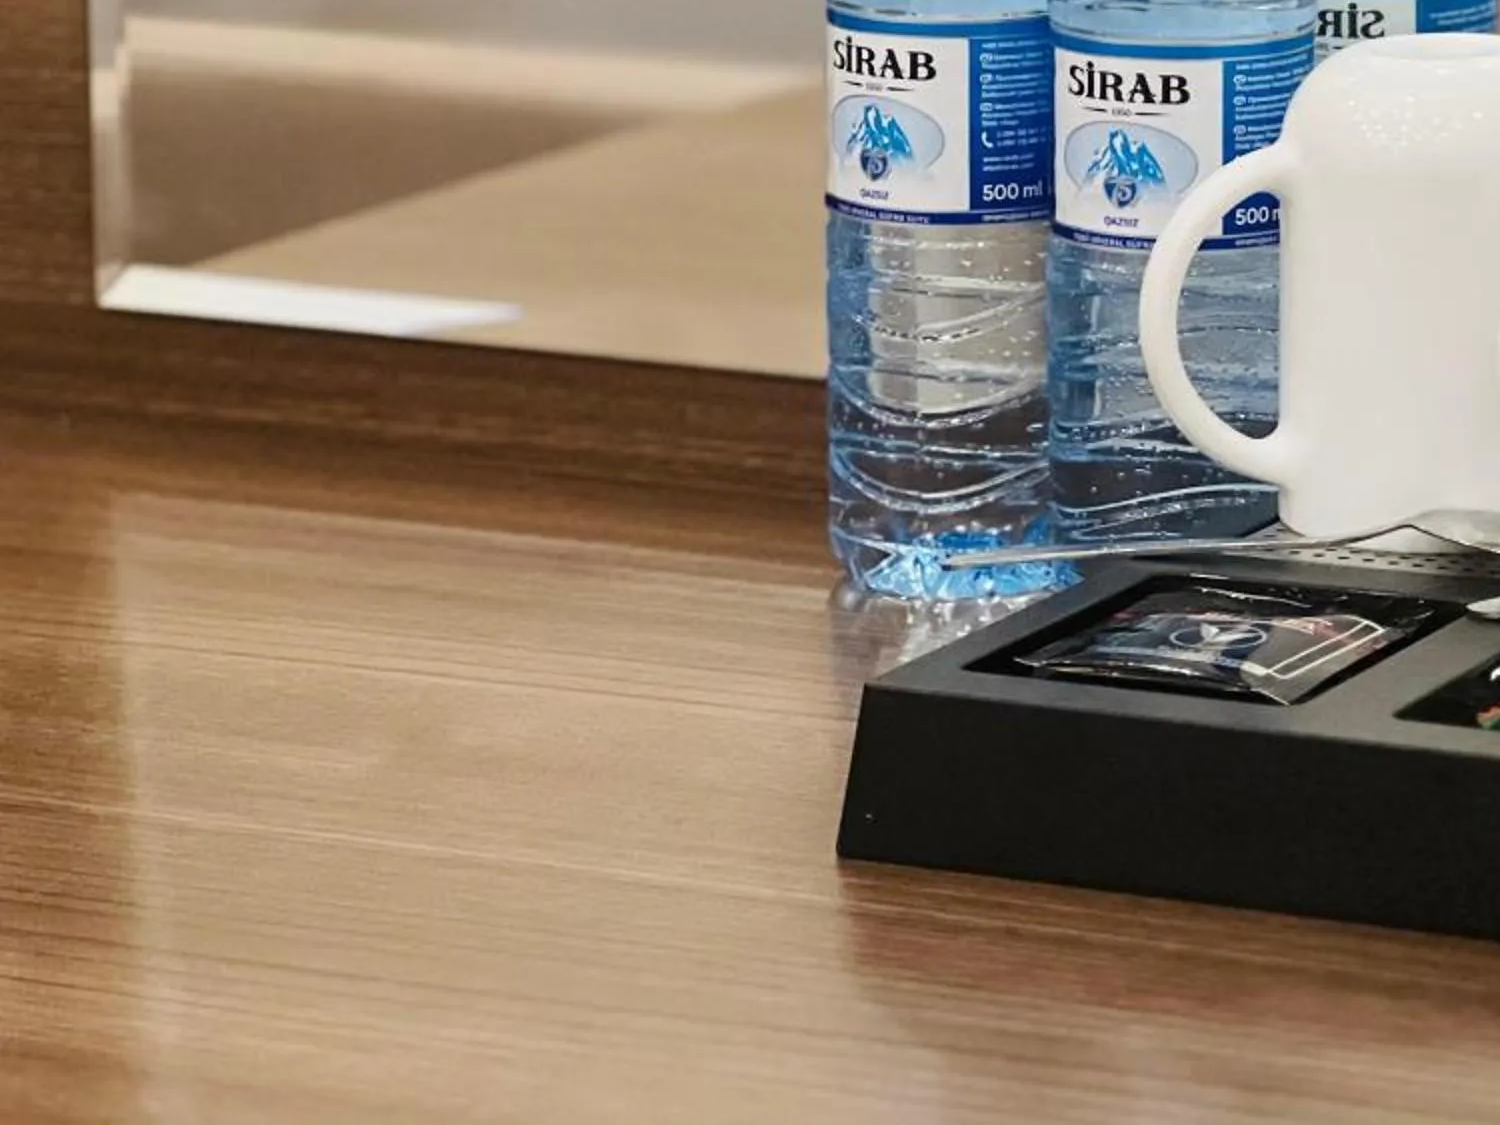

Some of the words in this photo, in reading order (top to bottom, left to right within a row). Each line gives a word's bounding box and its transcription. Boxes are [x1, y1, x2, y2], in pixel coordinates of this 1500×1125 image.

[833, 36, 937, 81] SİRAB
[1068, 60, 1191, 105] SİRAB
[982, 183, 1019, 202] 500
[1022, 180, 1043, 198] ml
[1235, 206, 1270, 225] 500
